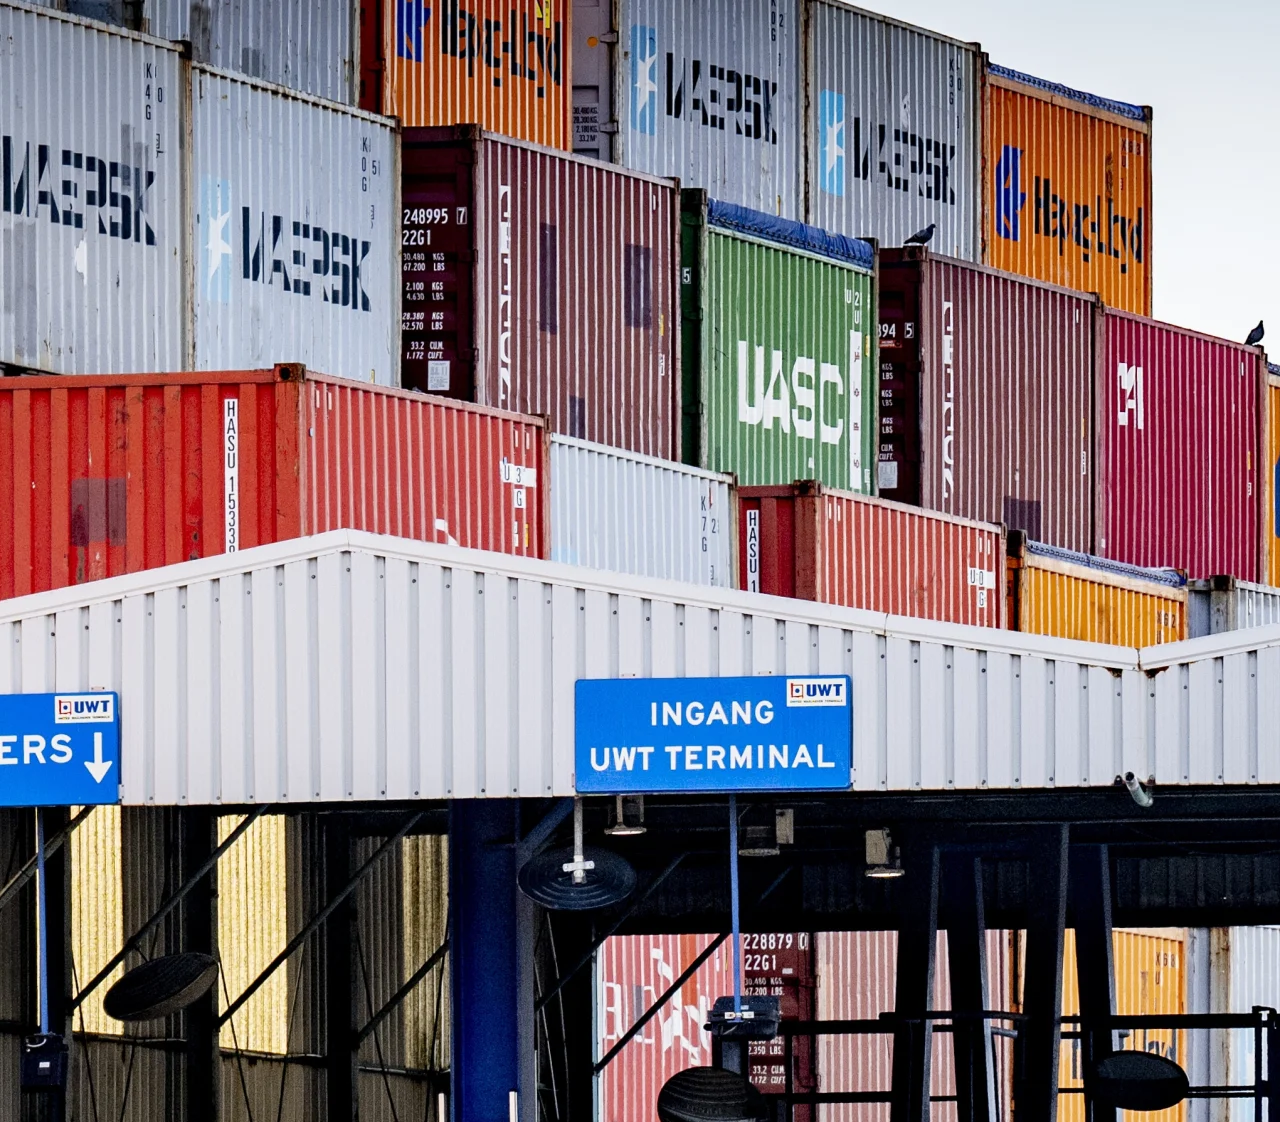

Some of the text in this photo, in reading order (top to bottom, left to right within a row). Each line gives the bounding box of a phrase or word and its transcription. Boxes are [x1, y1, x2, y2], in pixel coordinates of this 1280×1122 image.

[403, 208, 466, 225] 248995 7
[402, 229, 432, 246] 22G1
[403, 262, 426, 272] 67.200
[682, 267, 691, 284] 5
[738, 339, 844, 445] UASC
[226, 402, 237, 553] HASU 1533
[748, 511, 758, 574] HASU
[806, 683, 843, 697] UWT
[73, 699, 110, 715] UWT
[650, 700, 774, 727] INGANG
[590, 743, 835, 772] UWT TERMINAL
[743, 933, 794, 950] 228879
[744, 954, 777, 971] 22G1
